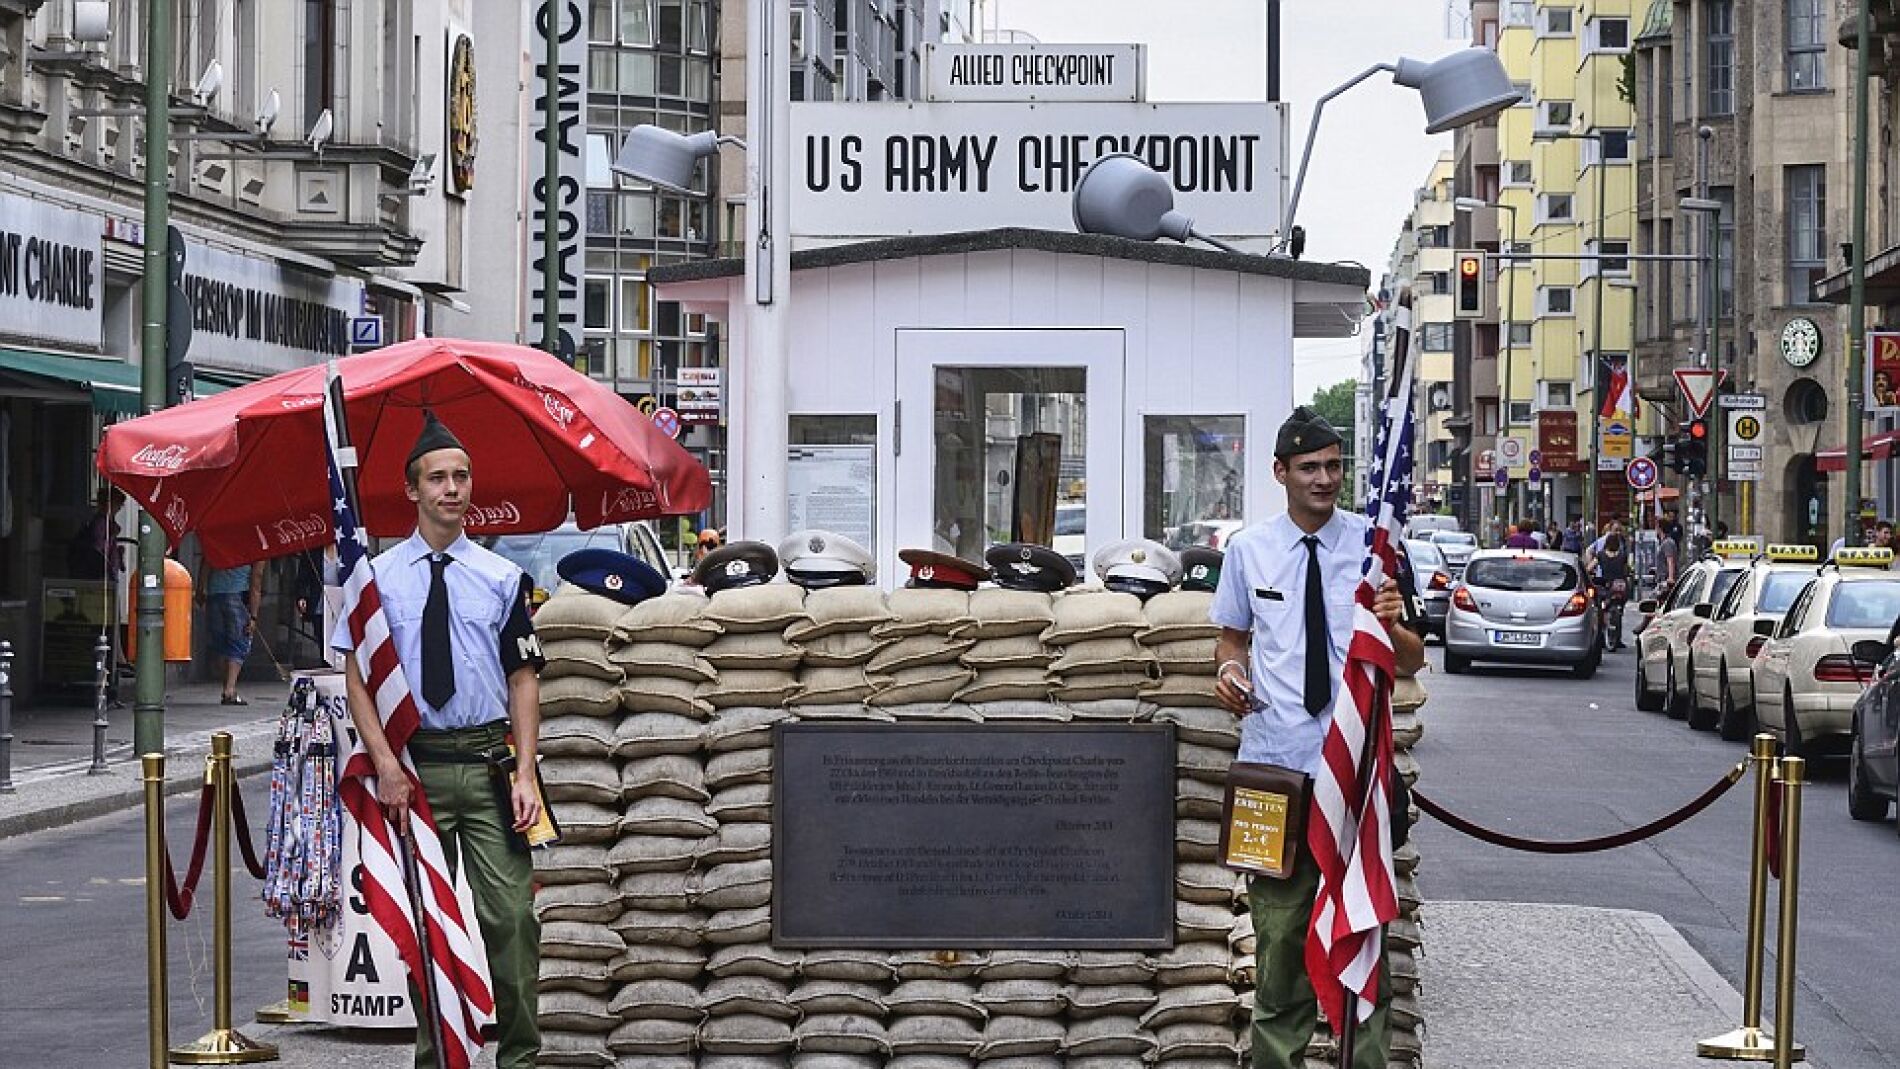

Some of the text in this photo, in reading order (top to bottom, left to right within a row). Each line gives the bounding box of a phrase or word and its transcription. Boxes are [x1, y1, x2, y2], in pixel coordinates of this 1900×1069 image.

[950, 54, 1115, 86] ALLIED CHECKPOINT
[534, 64, 580, 157] AM
[806, 135, 1260, 192] US ARMY CHEPOINT
[25, 235, 94, 310] CHARLIE
[532, 175, 579, 323] HAUS
[184, 273, 243, 340] UERSHOP
[1742, 420, 1753, 435] H
[517, 634, 541, 660] M
[331, 994, 404, 1017] STAMP
